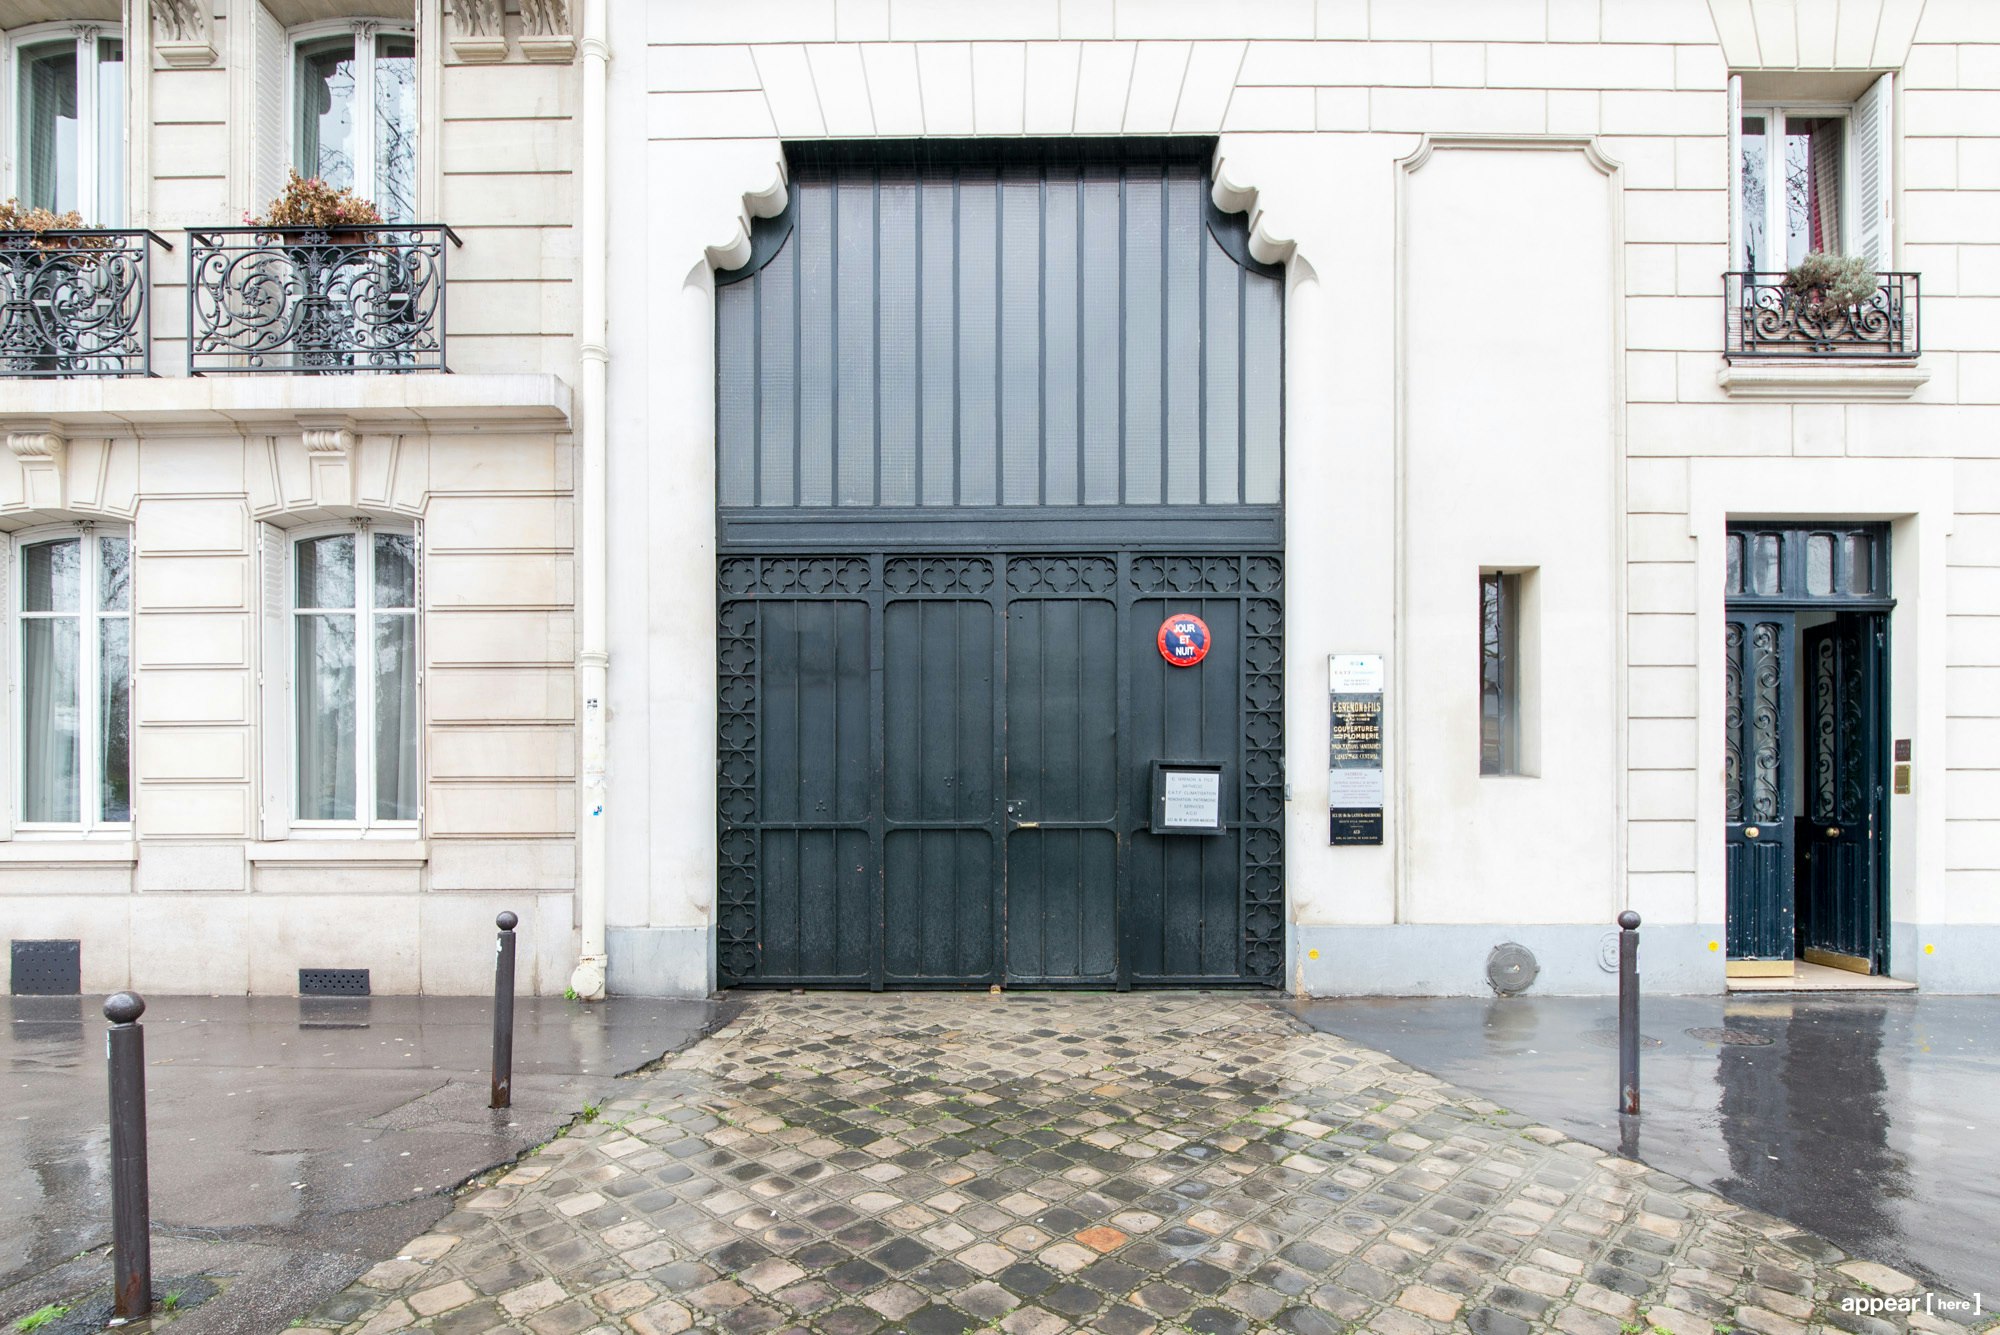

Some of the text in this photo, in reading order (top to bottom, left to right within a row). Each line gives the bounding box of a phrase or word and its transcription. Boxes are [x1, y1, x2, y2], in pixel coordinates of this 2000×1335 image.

[1174, 624, 1196, 632] JOUR
[1180, 635, 1190, 644] ET
[1175, 647, 1194, 656] NUIT
[1368, 702, 1381, 712] FILS
